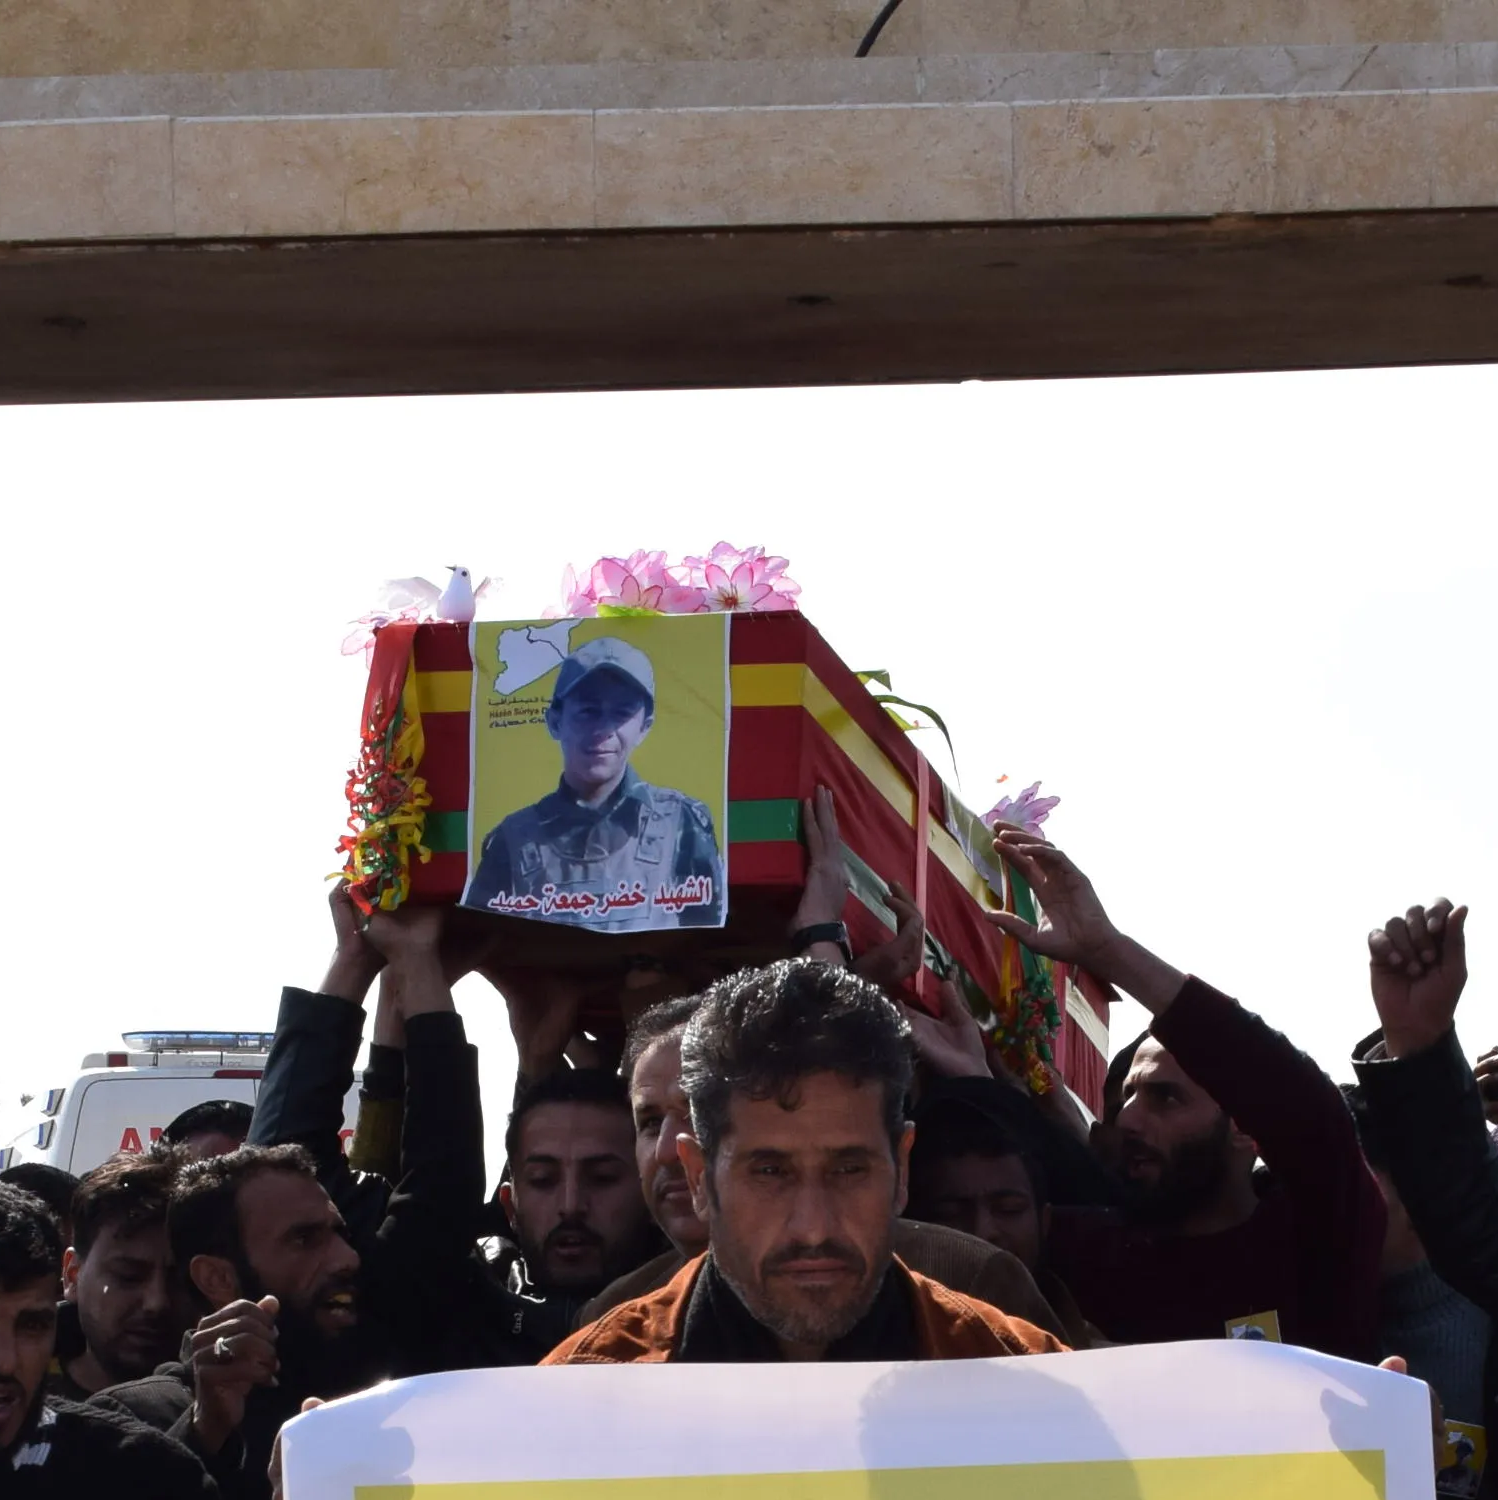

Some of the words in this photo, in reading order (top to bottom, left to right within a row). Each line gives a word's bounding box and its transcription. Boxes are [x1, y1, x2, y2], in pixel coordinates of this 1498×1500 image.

[489, 892, 540, 911] حميد
[542, 884, 597, 916] جمعة
[598, 881, 647, 915] خضر
[652, 876, 712, 912] الشهيد
